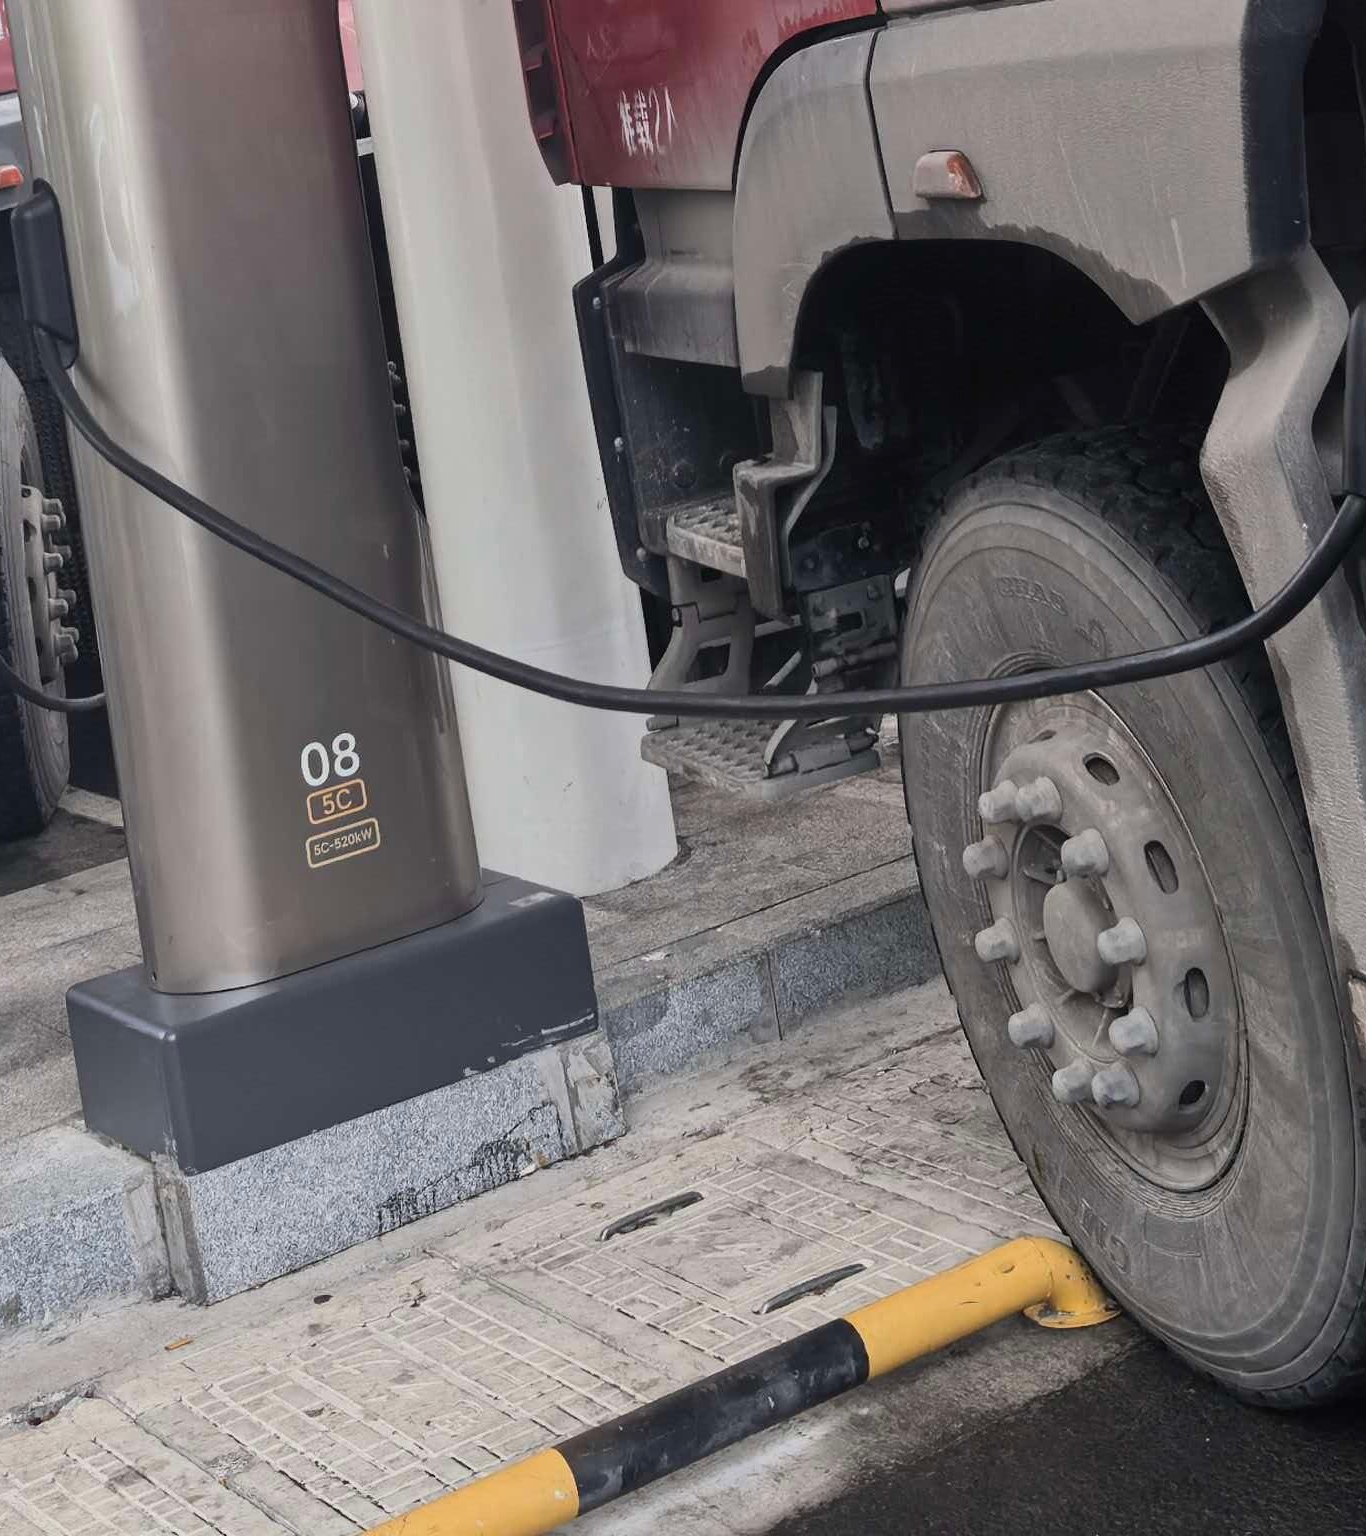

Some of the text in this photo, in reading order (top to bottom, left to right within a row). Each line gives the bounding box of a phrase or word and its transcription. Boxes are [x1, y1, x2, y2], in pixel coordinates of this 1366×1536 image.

[300, 732, 361, 787] 08
[322, 788, 353, 815] 5C
[313, 826, 373, 857] 5C-520kW
